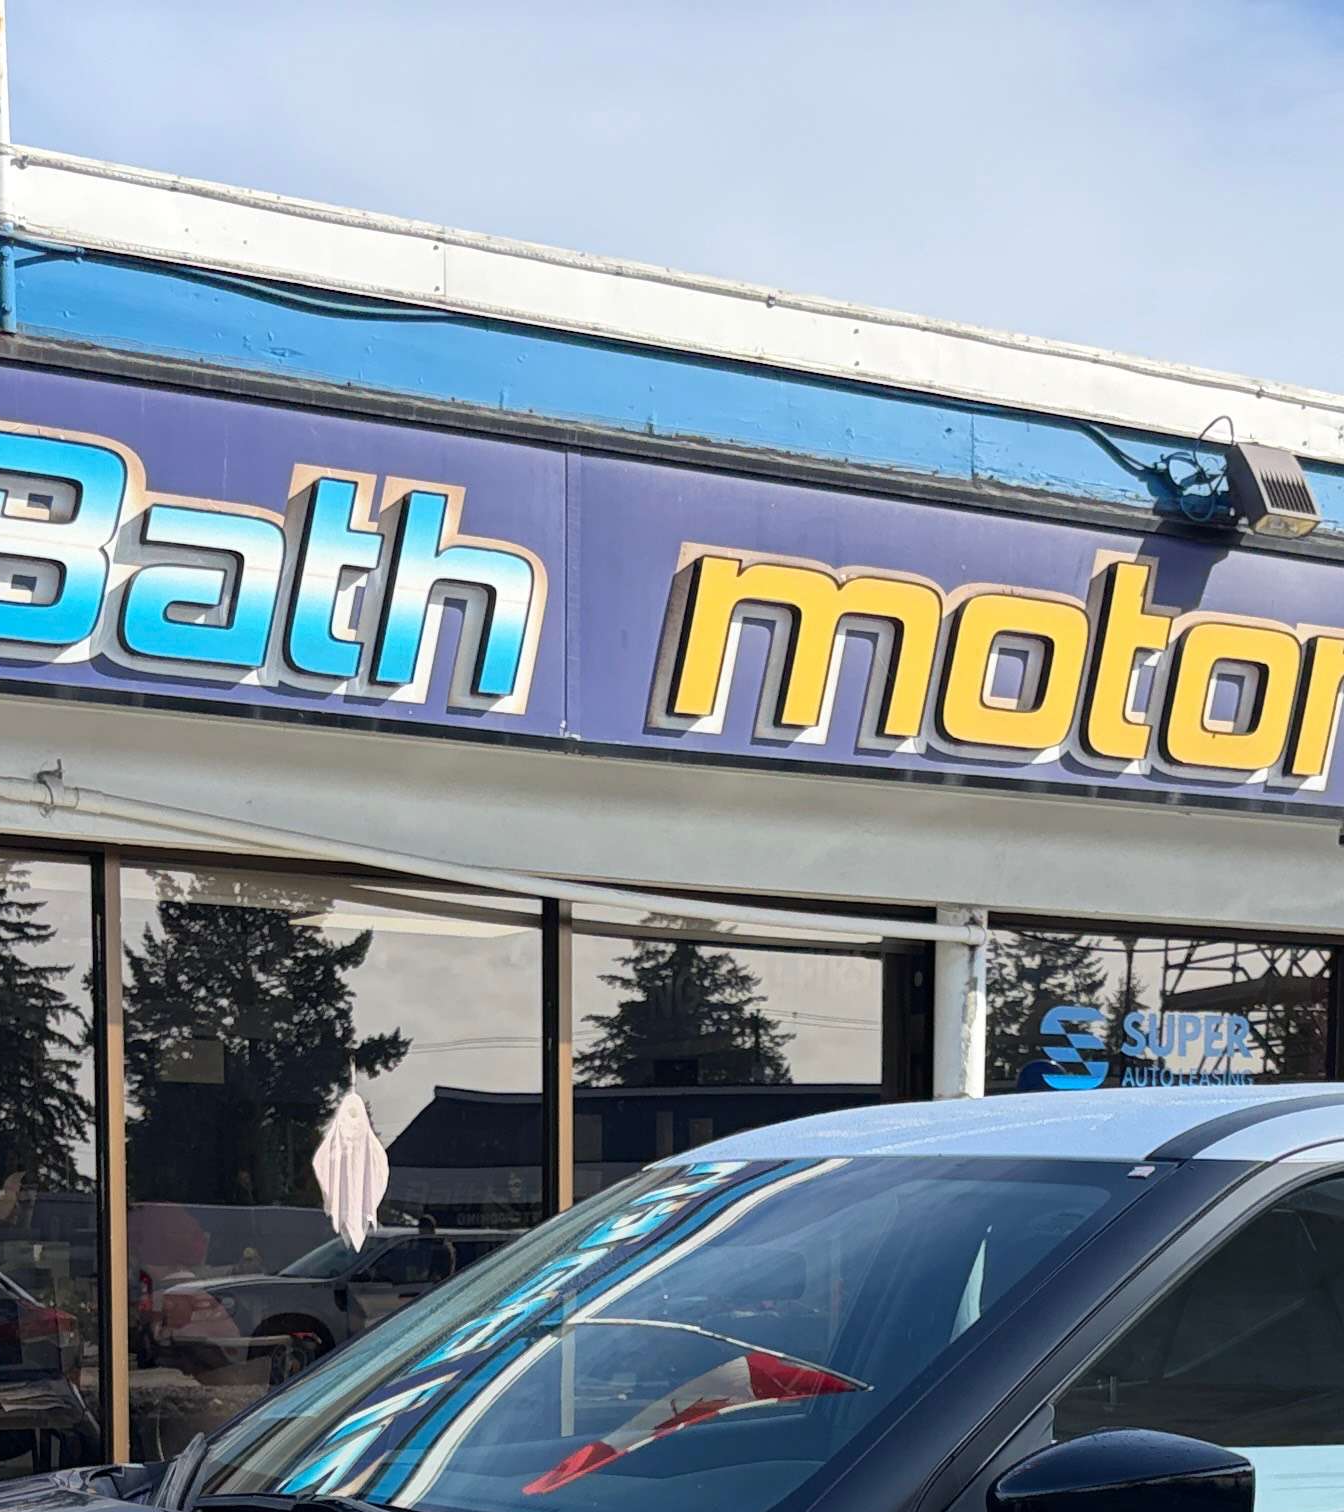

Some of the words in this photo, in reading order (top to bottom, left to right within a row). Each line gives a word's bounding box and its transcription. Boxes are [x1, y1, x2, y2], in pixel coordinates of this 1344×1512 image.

[1120, 1010, 1254, 1058] SUPER
[1120, 1067, 1176, 1088] AUTO
[1179, 1069, 1255, 1089] LEASING
